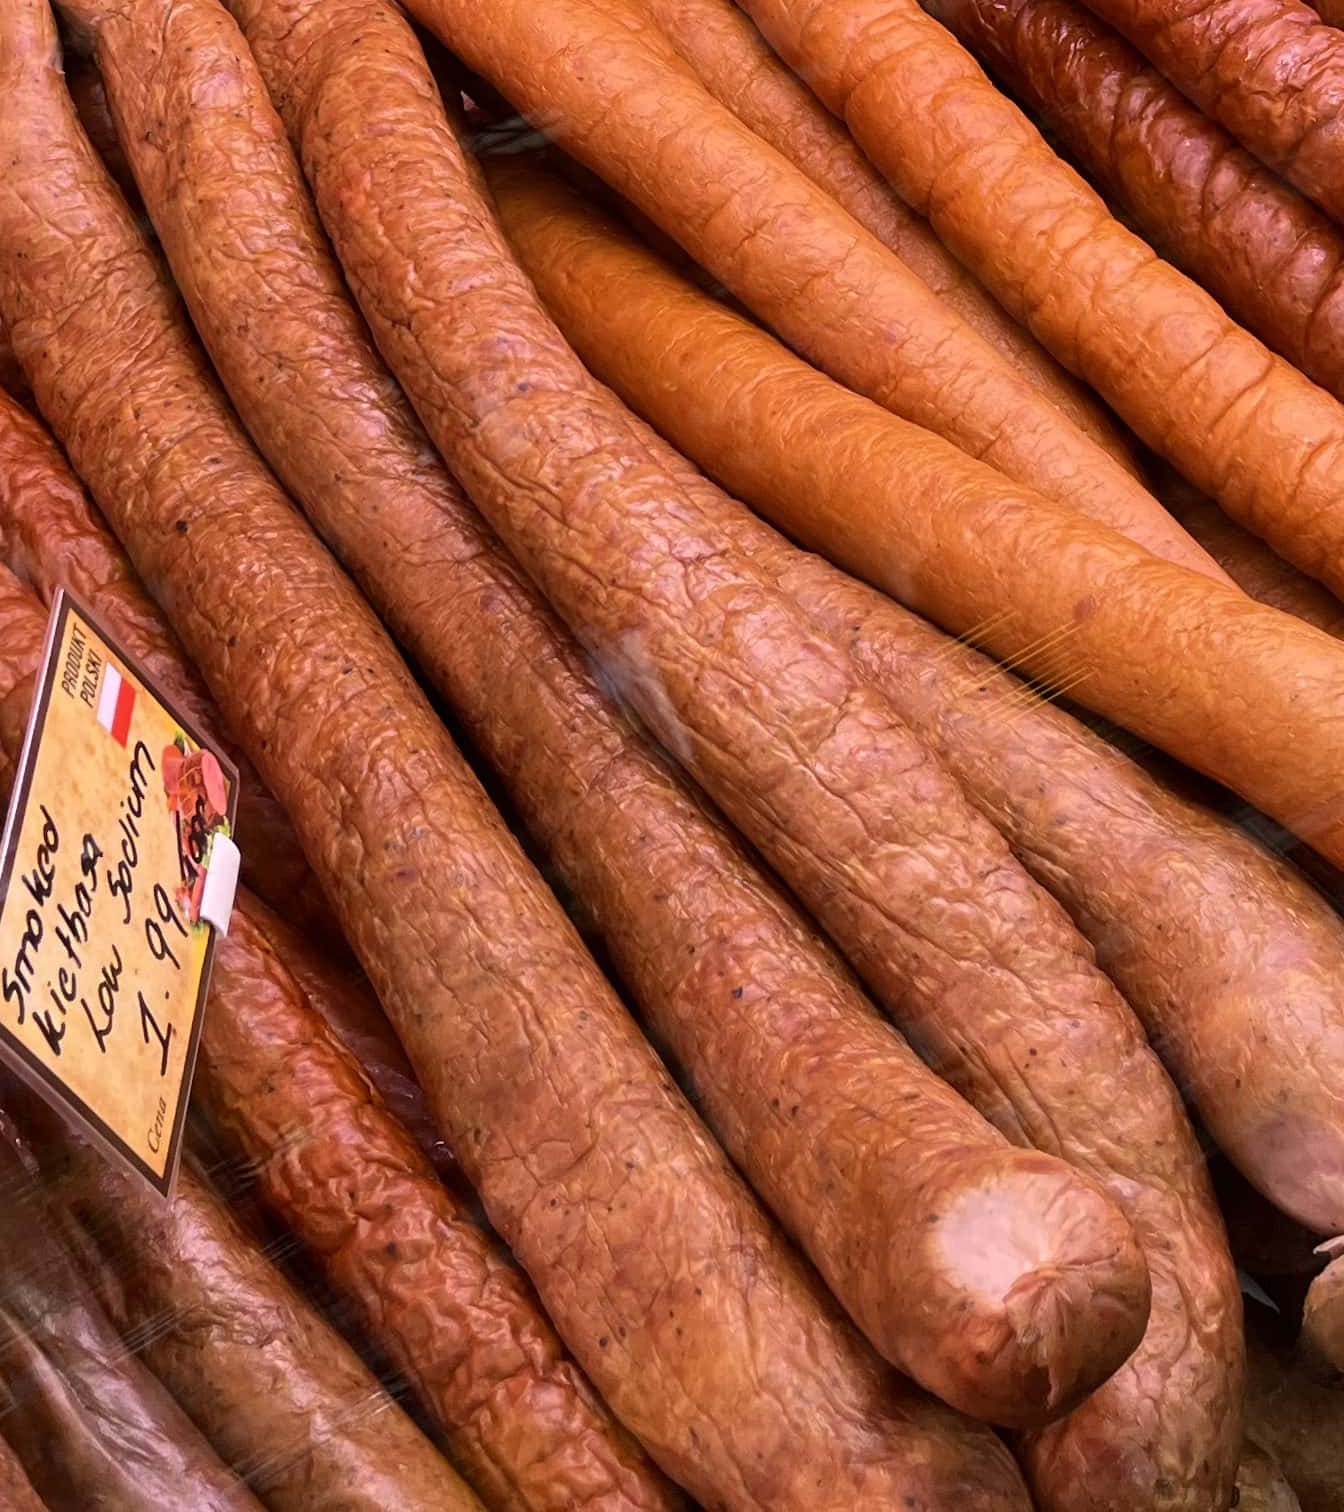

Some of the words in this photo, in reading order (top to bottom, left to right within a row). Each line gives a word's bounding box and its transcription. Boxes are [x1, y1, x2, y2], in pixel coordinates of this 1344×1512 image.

[61, 623, 87, 699] PRODUKT
[81, 651, 101, 708] POLSKI
[2, 805, 59, 1026] Smoked
[81, 943, 123, 1054] Low
[146, 1096, 168, 1155] Cena
